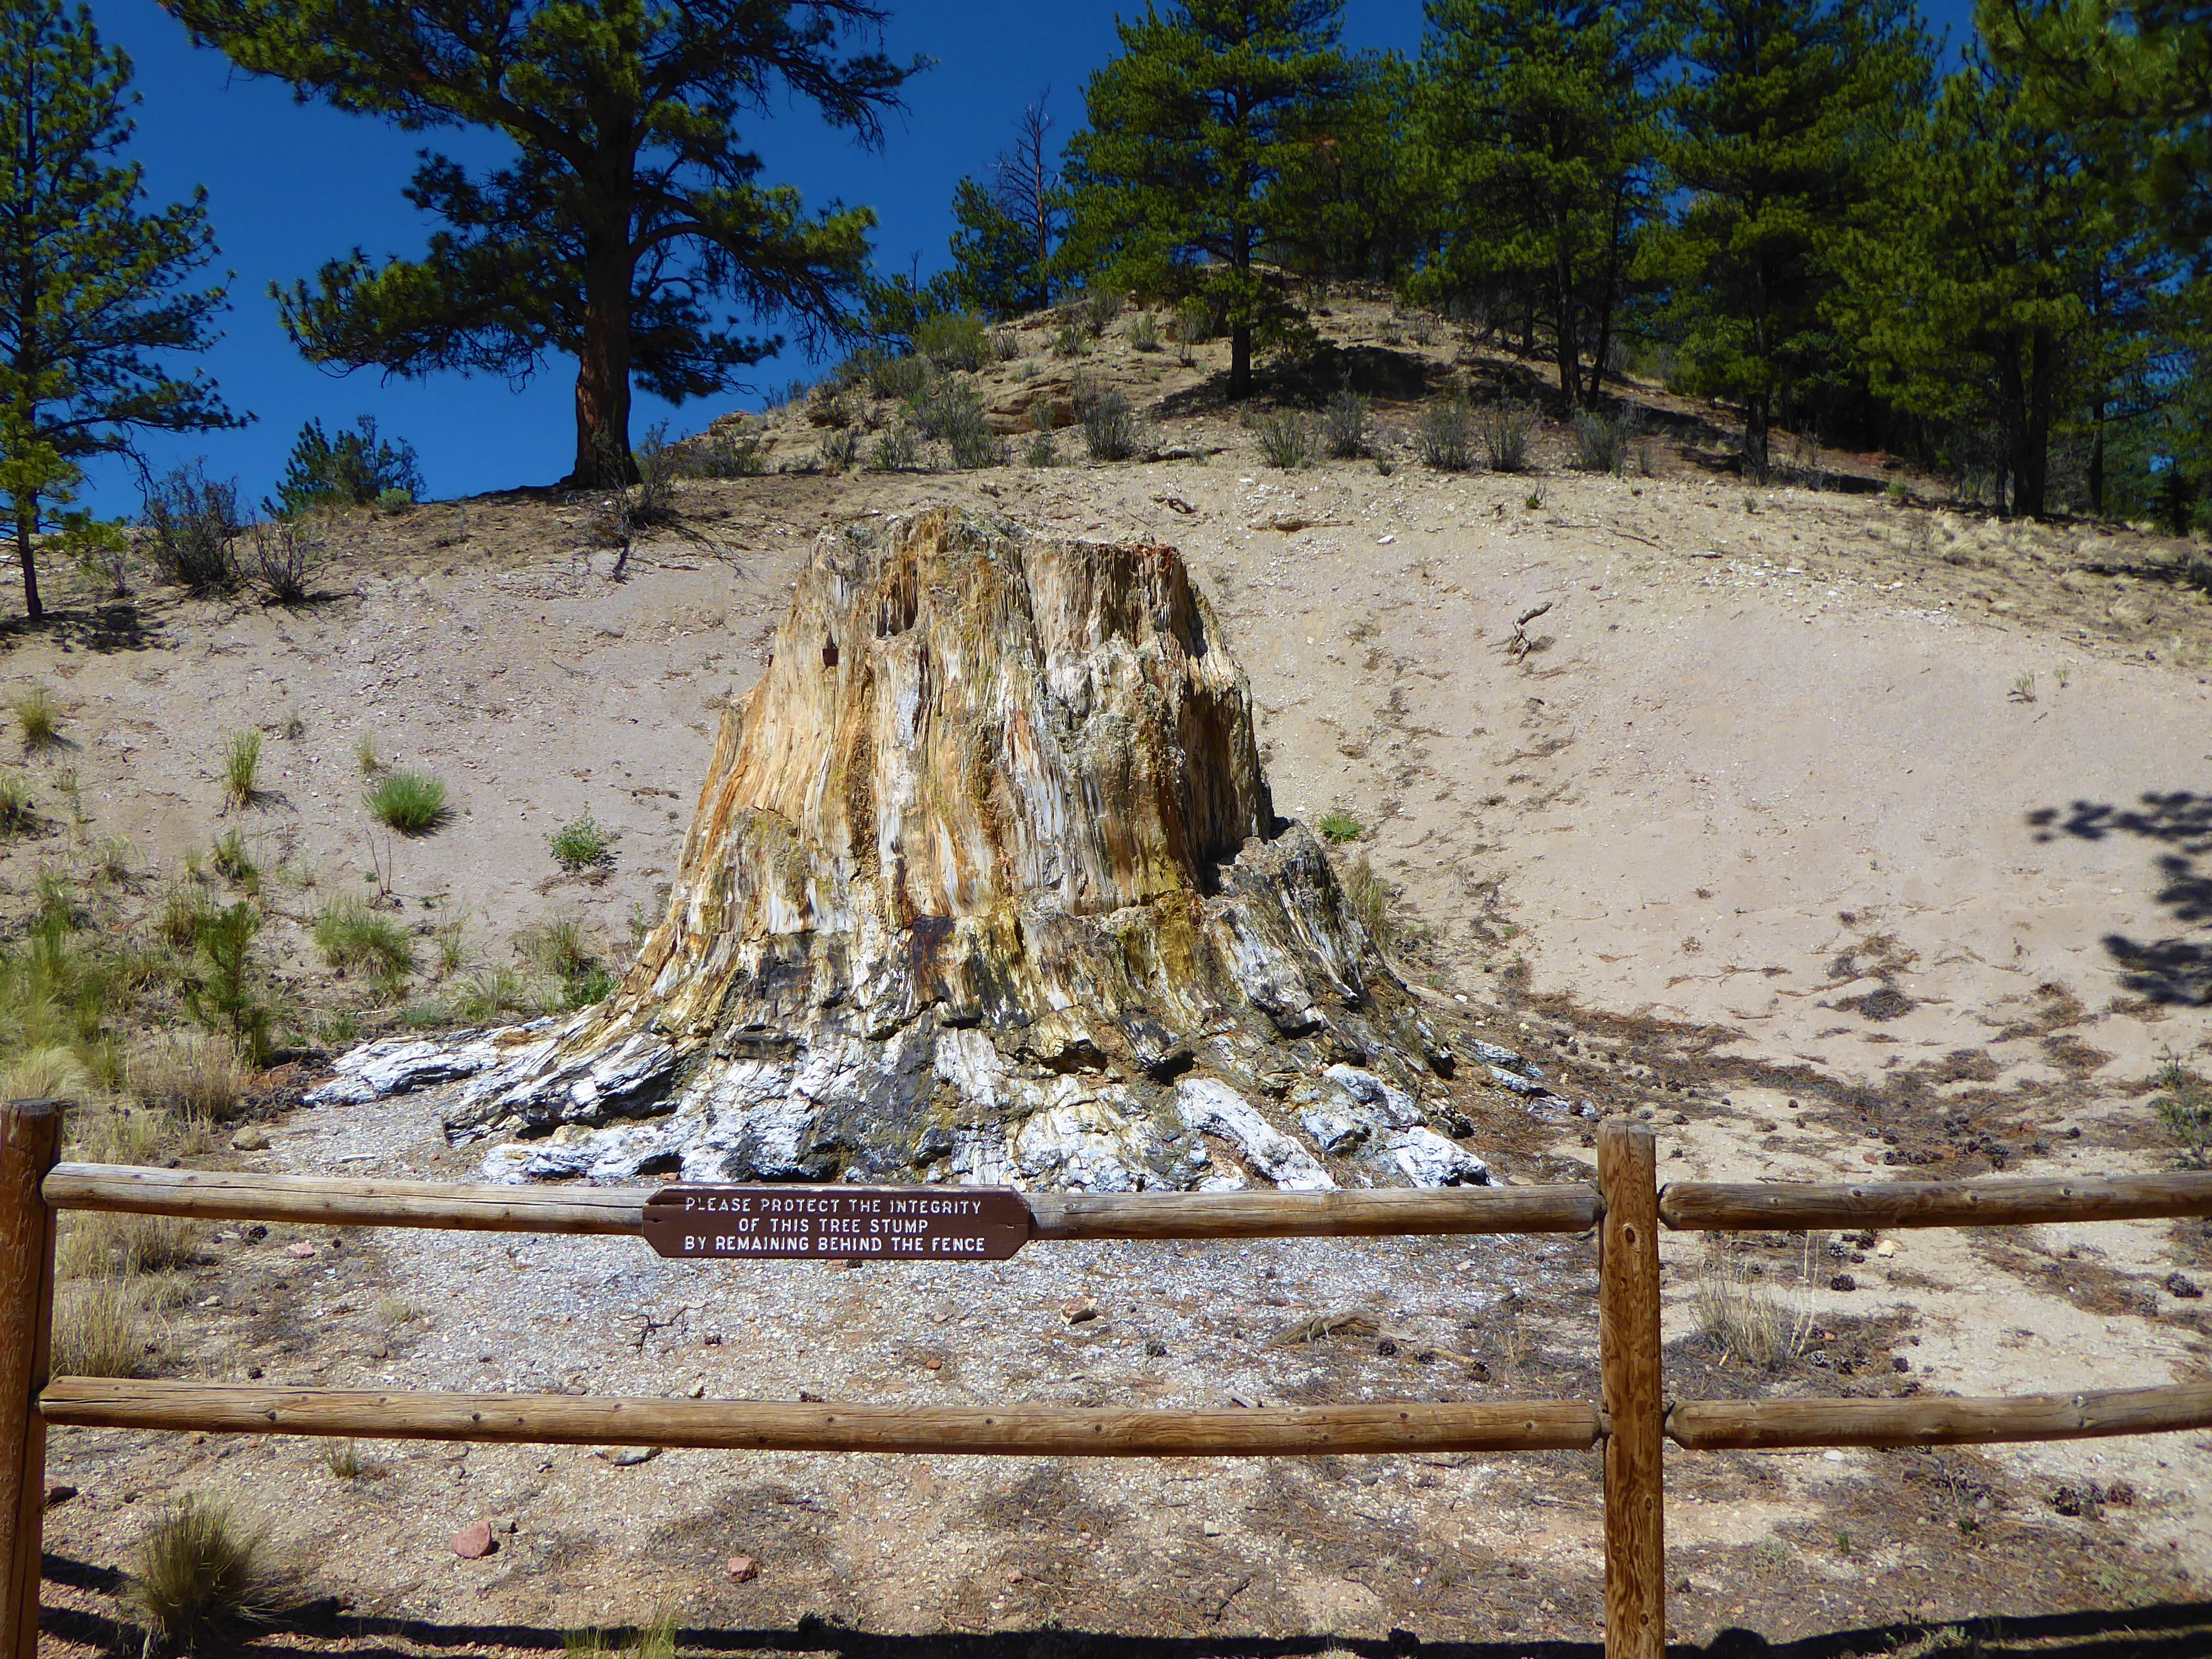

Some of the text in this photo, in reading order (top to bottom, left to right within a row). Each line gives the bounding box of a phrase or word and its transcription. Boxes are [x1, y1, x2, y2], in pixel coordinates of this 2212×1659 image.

[685, 1197, 981, 1214] PLEASE PROTECT THE INTEGRITY
[738, 1218, 928, 1233] OF THIS TREE STUMP
[684, 1235, 985, 1252] BY REMAINING BEHIND THE FENCE
